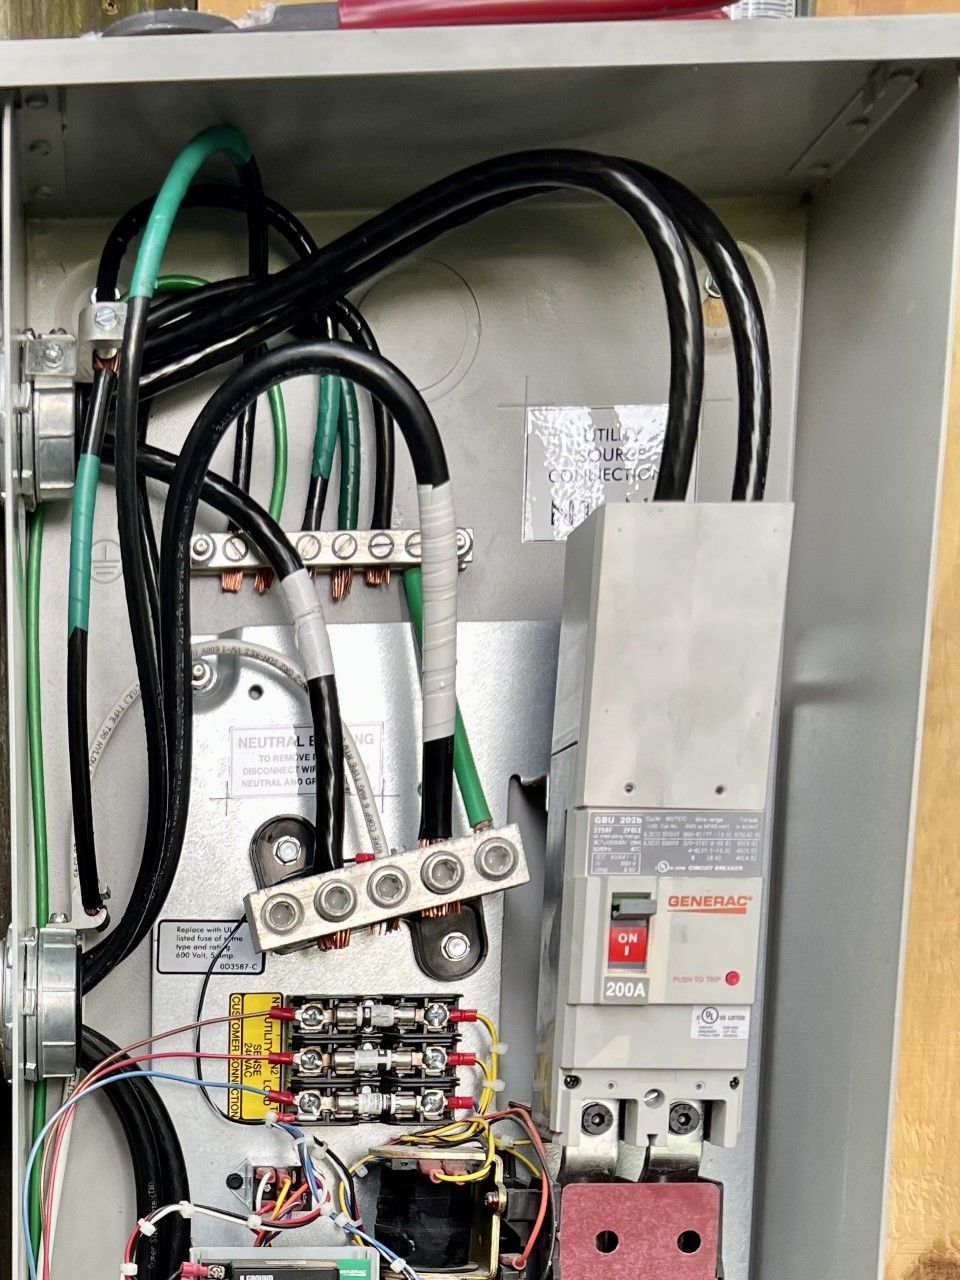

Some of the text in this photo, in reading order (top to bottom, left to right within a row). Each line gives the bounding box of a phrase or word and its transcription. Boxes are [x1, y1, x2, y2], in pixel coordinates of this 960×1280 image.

[238, 736, 305, 749] NEUTRAL
[259, 753, 310, 763] TO REMOVE
[242, 765, 299, 775] DISCONNECT
[242, 780, 282, 788] NEUTRAL
[284, 778, 303, 787] AND
[594, 816, 615, 824] GBU
[668, 895, 748, 908] GENERAC
[176, 926, 205, 934] Replace
[206, 926, 222, 934] with
[176, 934, 194, 942] listed
[197, 934, 210, 942] fuse
[214, 934, 223, 942] of
[617, 933, 638, 944] ON
[176, 943, 192, 952] type
[209, 944, 231, 952] ratg
[672, 976, 721, 984] PUSH TO TRIP
[605, 981, 646, 998] 200A
[263, 1017, 273, 1053] UTILITY
[230, 995, 241, 1119] CUSTOMER ONNCTION
[243, 1042, 253, 1078] 24VAC
[253, 1043, 262, 1077] SENSE
[270, 1064, 279, 1075] N2
